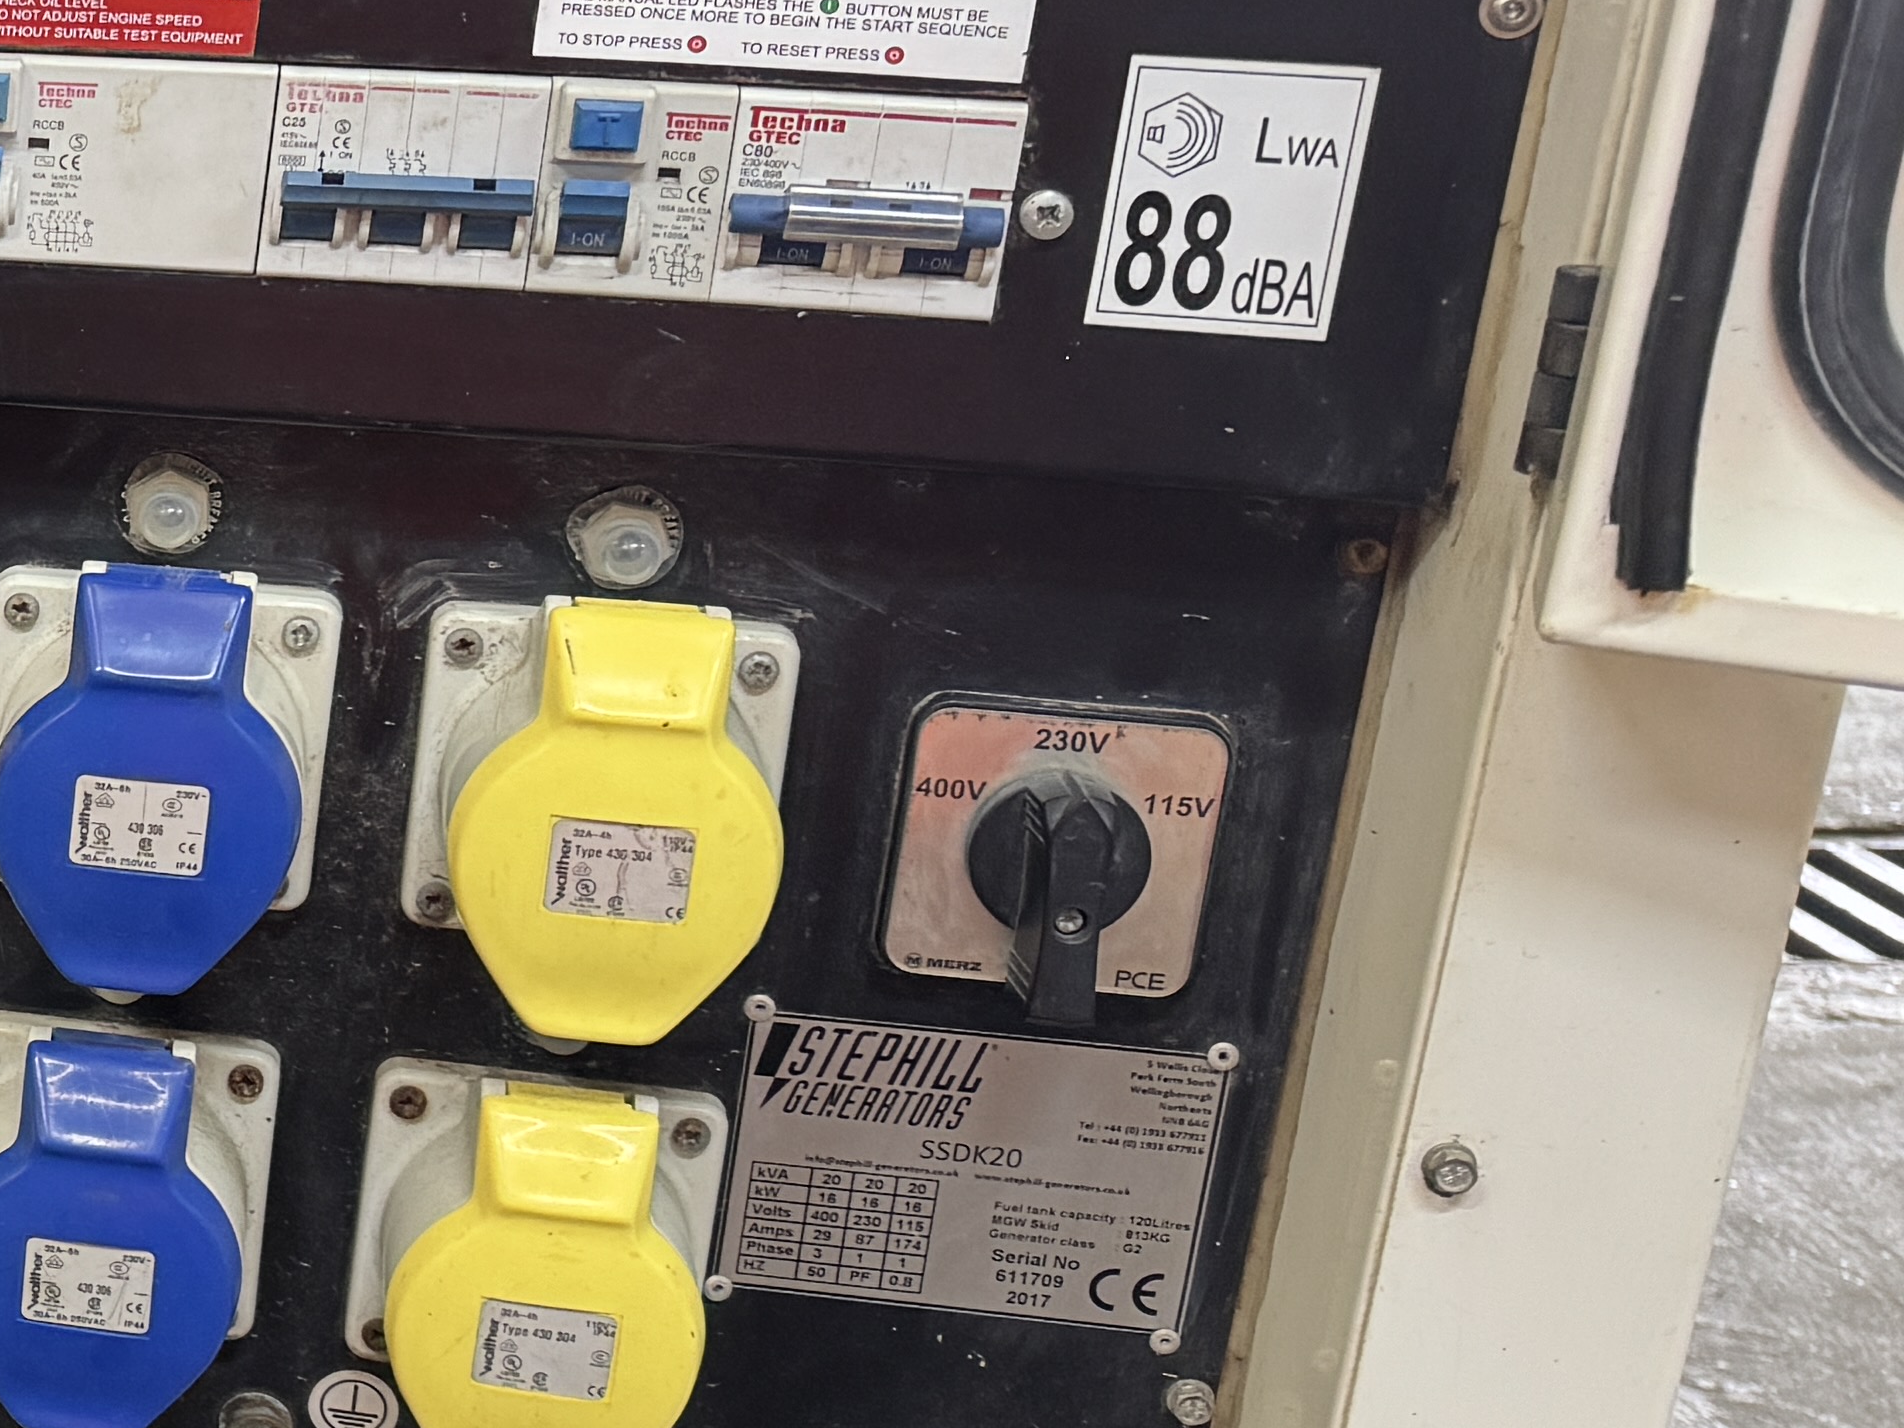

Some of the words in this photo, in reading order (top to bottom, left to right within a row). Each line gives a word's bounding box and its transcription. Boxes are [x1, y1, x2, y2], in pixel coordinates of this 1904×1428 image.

[12, 10, 41, 21] NOT
[42, 11, 96, 23] ADJUST
[99, 12, 152, 24] ENGINE
[156, 14, 202, 26] SPEED
[784, 0, 814, 12] THE
[846, 3, 913, 18] BUTTON
[917, 7, 964, 21] MUST
[968, 10, 989, 22] BE
[561, 4, 635, 18] PRESSED
[641, 7, 686, 21] ONCE
[690, 10, 738, 23] MORE
[744, 12, 765, 25] TO
[770, 14, 820, 28] BEGIN
[826, 17, 856, 30] THE
[861, 19, 914, 34] START
[917, 22, 1009, 39] SEQUENCE
[54, 28, 119, 40] SUITABLE
[123, 30, 158, 42] TEST
[161, 31, 243, 44] EQUIPMENT
[559, 33, 578, 44] TO
[583, 34, 624, 47] STOP
[629, 36, 683, 49] PRESS
[741, 42, 762, 55] TO
[767, 44, 821, 58] RESET
[825, 47, 879, 61] PRESS
[748, 130, 800, 145] GTEC
[662, 151, 696, 161] RCCB
[743, 144, 773, 158] C80
[1115, 190, 1232, 311] 88
[1231, 257, 1314, 318] dBA
[1034, 729, 1111, 754] 230V
[916, 777, 987, 801] 400V
[1144, 794, 1215, 818] 115V
[575, 845, 602, 858] Type
[927, 958, 982, 972] MERZ
[1114, 971, 1166, 991] PCE
[789, 1024, 989, 1093] STEPHILL
[783, 1080, 971, 1130] GENERATORS
[920, 1140, 1022, 1168] SSDK20
[752, 1203, 791, 1217] Volts
[749, 1223, 794, 1237] Amps
[992, 1249, 1047, 1267] Serial
[1053, 1256, 1080, 1270] No
[995, 1270, 1064, 1288] 611709
[1006, 1292, 1052, 1308] 2017
[1089, 1269, 1165, 1316] CE
